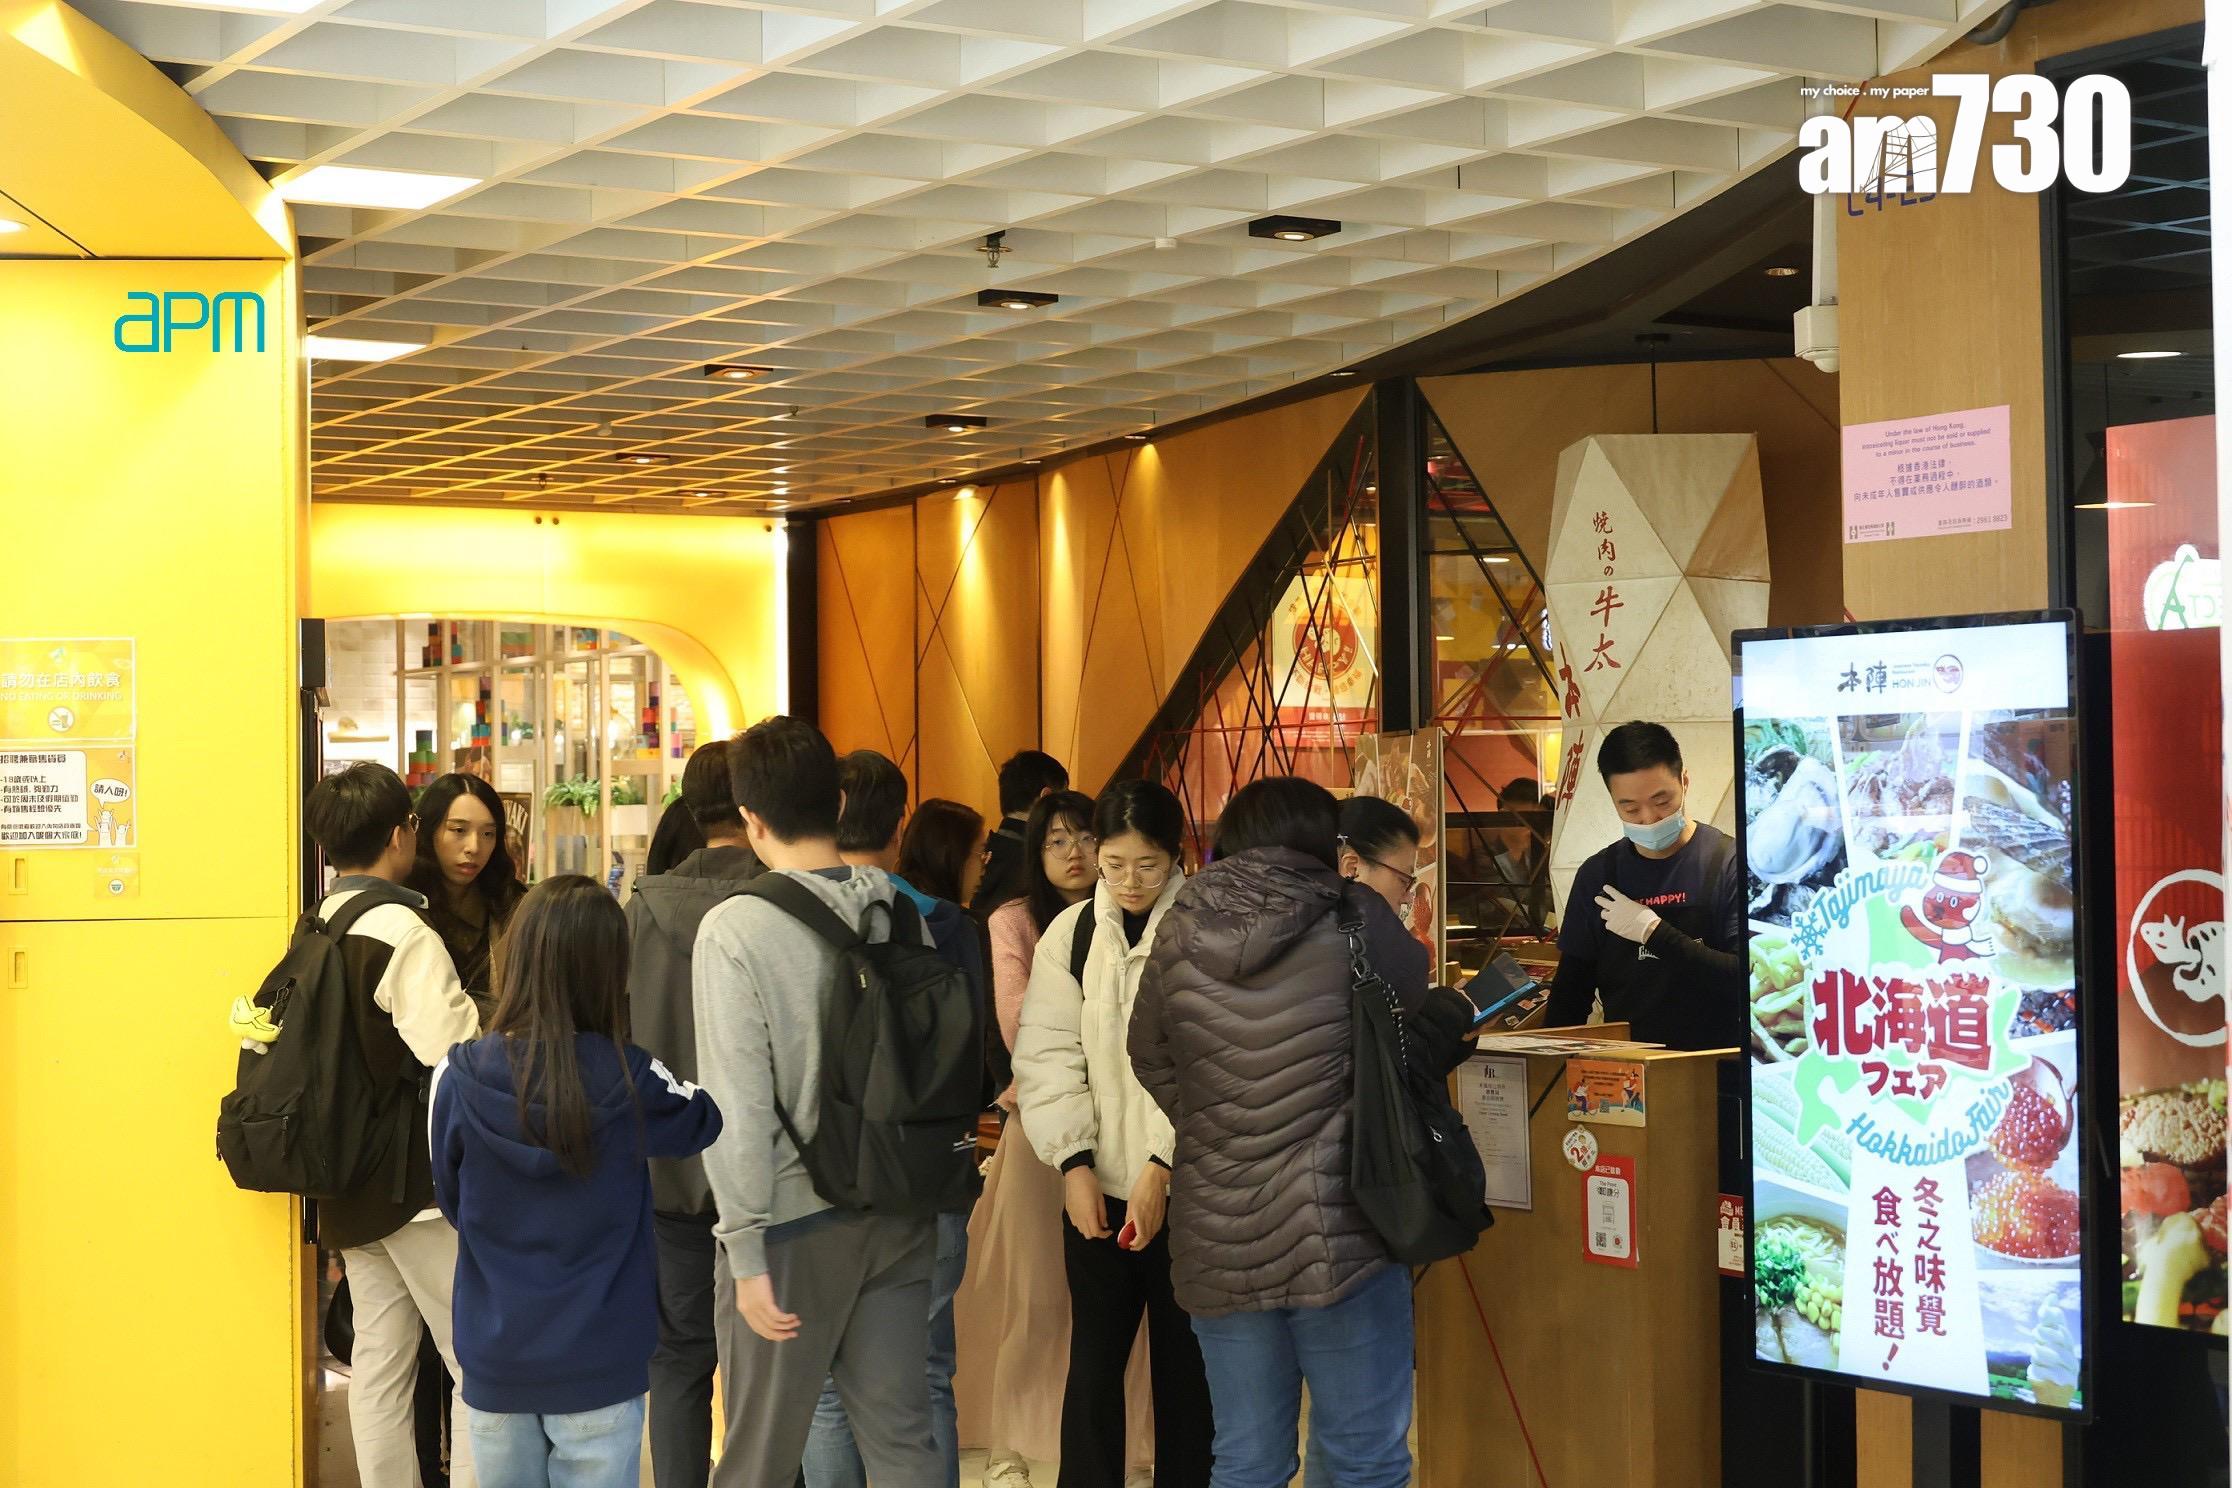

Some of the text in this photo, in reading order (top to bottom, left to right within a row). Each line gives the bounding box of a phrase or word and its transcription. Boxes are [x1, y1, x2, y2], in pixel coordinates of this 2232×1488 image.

[1837, 660, 1887, 694] 本陣
[1645, 892, 1686, 906] HAPPY!
[1813, 866, 1928, 930] Tajimaya
[1812, 967, 1991, 1071] 北海道
[1861, 1060, 1948, 1100] フェア
[1846, 1082, 2010, 1167] Hokkaido Fair
[1913, 1176, 1947, 1337] 冬之味覺
